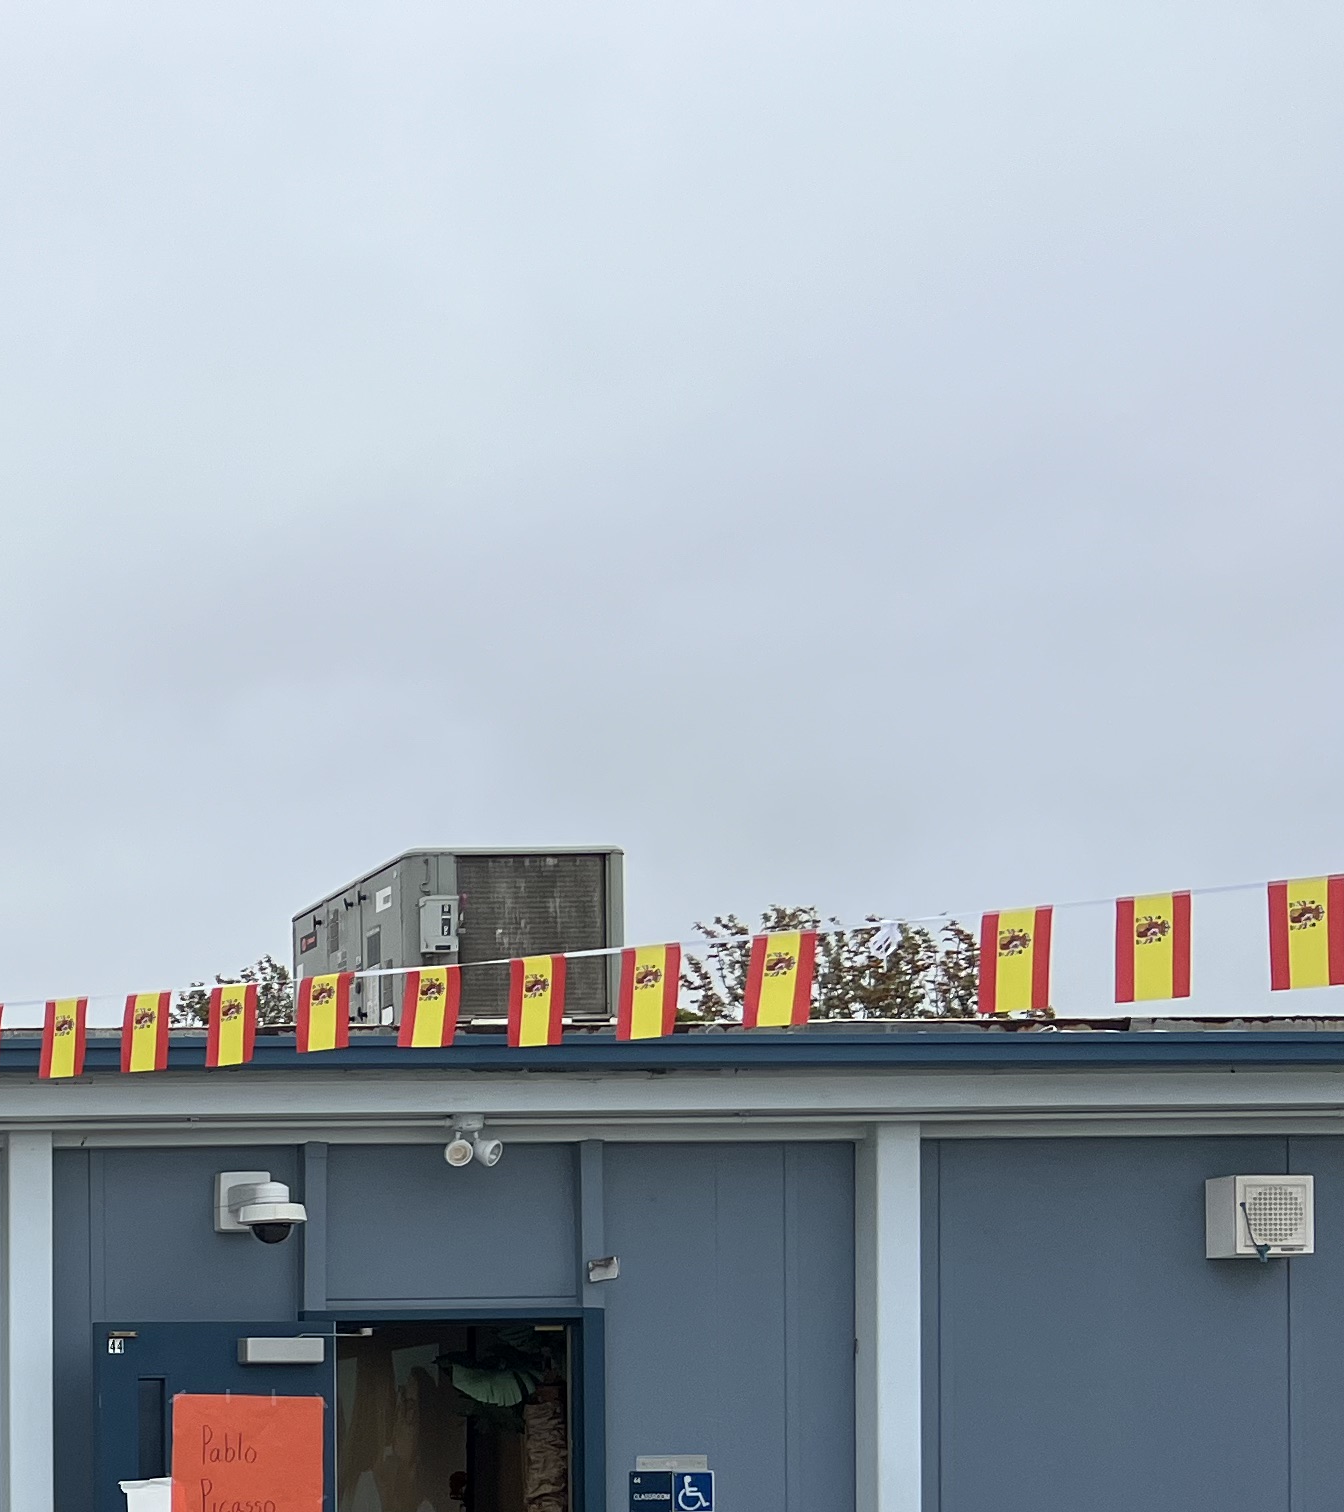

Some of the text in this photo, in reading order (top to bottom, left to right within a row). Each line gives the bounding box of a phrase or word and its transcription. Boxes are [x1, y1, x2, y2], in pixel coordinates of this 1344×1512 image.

[109, 1339, 123, 1354] 44
[201, 1424, 257, 1465] Pablo
[633, 1493, 671, 1501] CLASSROOM
